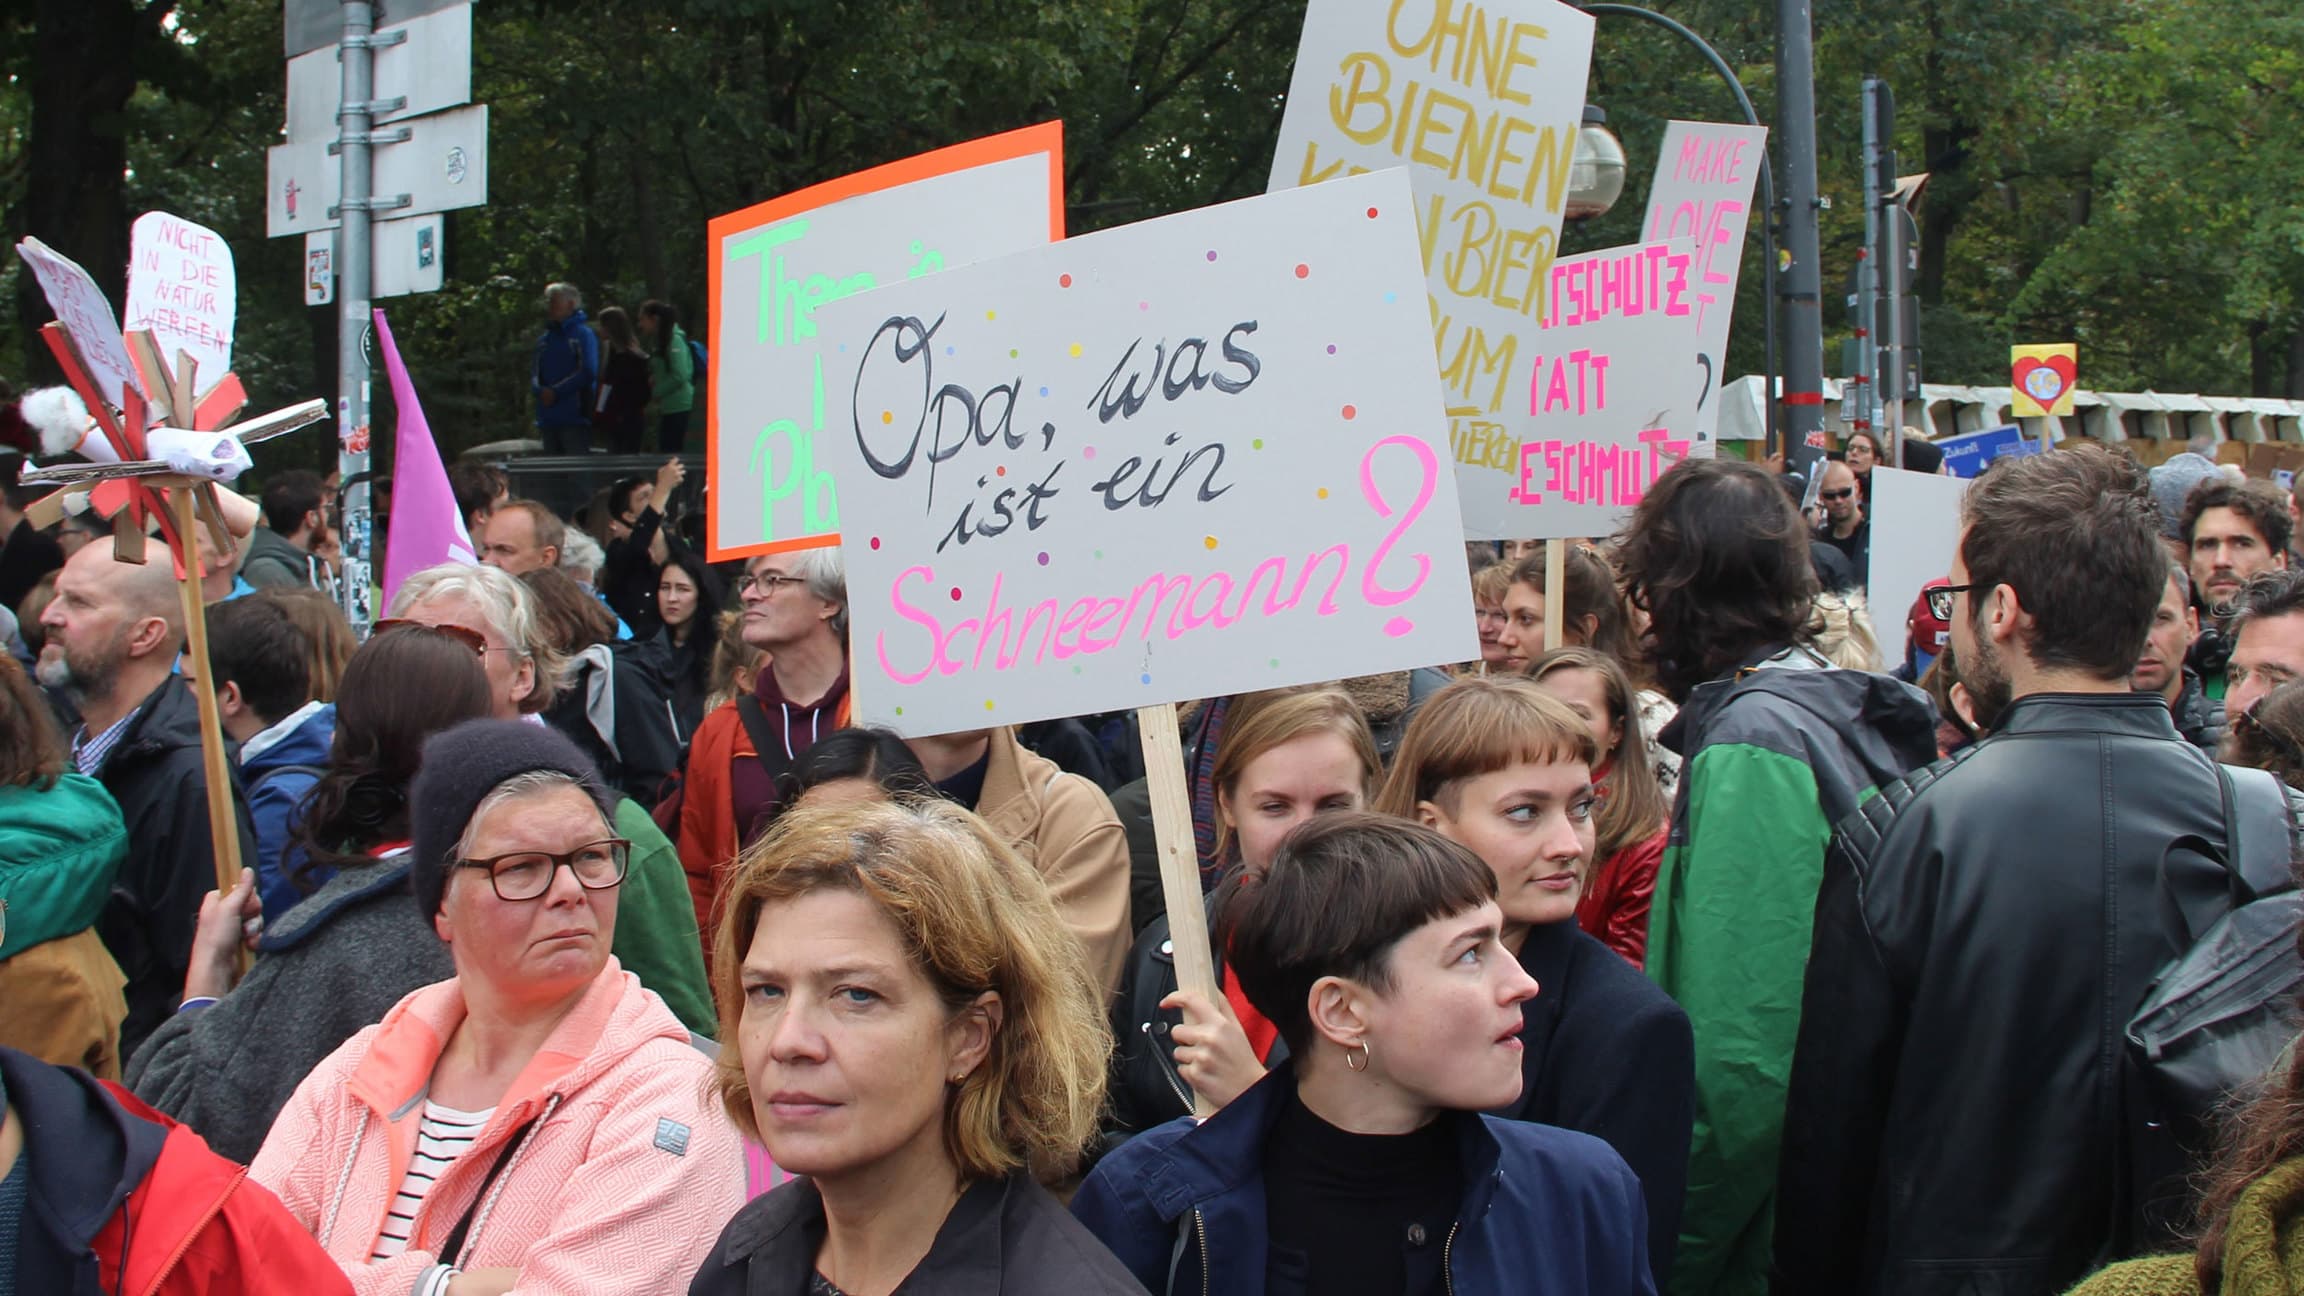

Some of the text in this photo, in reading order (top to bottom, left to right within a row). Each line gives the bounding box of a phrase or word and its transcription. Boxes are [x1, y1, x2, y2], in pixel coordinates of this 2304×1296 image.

[1387, 0, 1548, 106] OHNE
[1329, 52, 1577, 215] BIENEN
[1674, 133, 1747, 184] MAKE
[141, 246, 221, 288] IN DIE
[158, 220, 214, 259] NICHT
[1443, 200, 1556, 326] BIER
[1542, 245, 1691, 329] TSCHUTZ
[136, 301, 227, 353] WERFEN
[155, 278, 217, 315] NATUR
[1429, 292, 1518, 415] UM
[853, 309, 1054, 516] Opa,
[1087, 319, 1261, 424] was
[936, 431, 1234, 553] ist ein
[876, 434, 1439, 685] Schneemann?
